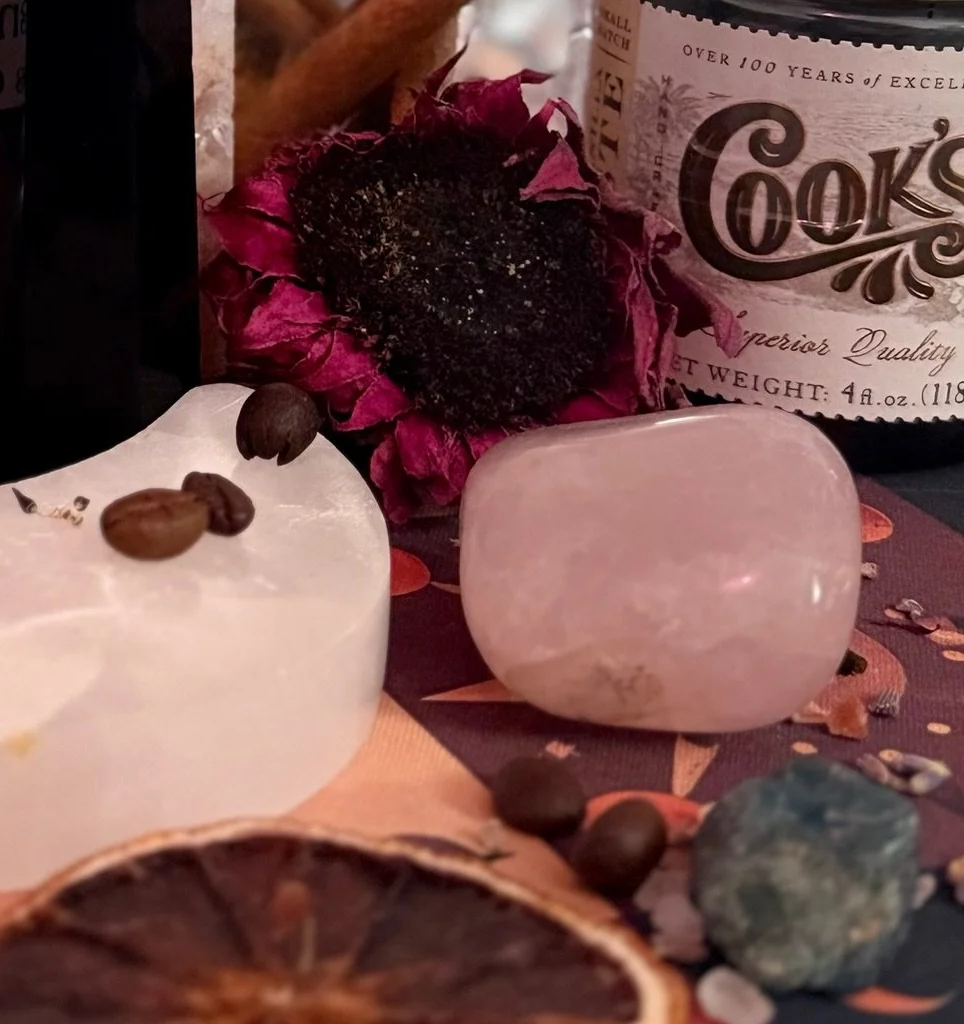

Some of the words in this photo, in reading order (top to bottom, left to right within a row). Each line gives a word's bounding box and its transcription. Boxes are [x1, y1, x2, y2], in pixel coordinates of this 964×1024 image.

[682, 44, 730, 66] OVER
[739, 57, 777, 75] 100
[787, 65, 855, 85] YEARS
[863, 73, 882, 89] of
[889, 76, 964, 91] EXCEL
[700, 310, 831, 359] perior
[842, 327, 957, 377] Quality
[669, 354, 701, 376] ET
[707, 364, 829, 403] WEIGHT:
